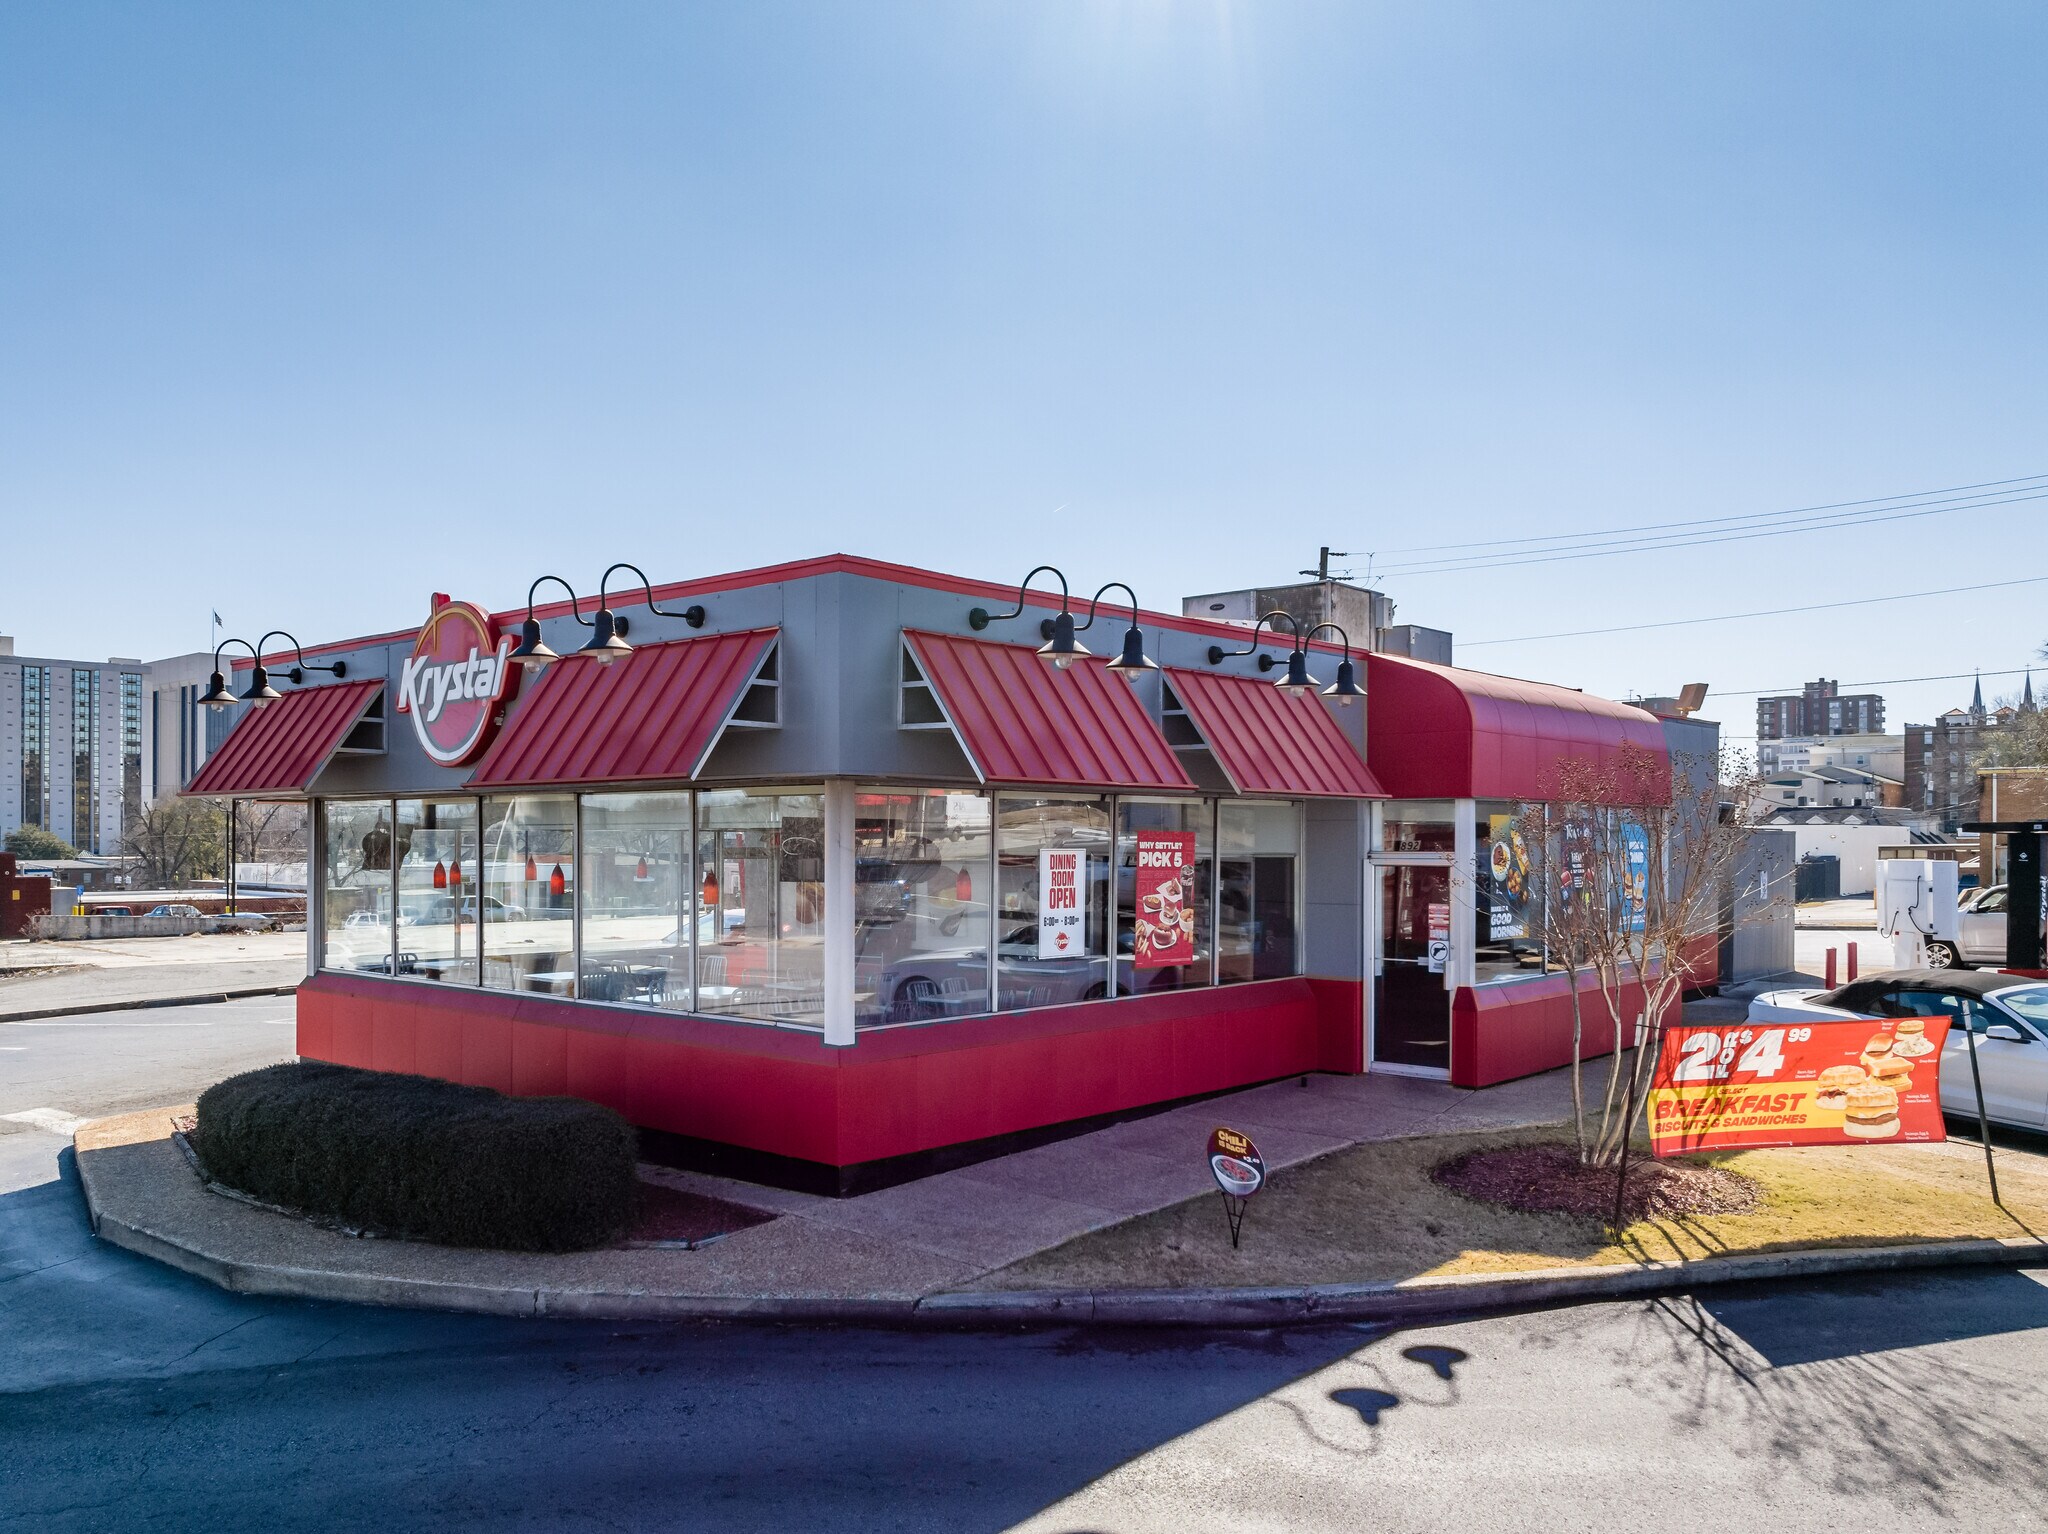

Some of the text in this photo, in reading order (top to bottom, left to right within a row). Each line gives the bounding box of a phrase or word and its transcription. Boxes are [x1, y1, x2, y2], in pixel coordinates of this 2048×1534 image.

[398, 643, 508, 722] Krystal
[1401, 841, 1420, 850] 892
[1049, 854, 1077, 870] DINING
[1139, 851, 1182, 868] PICK 5
[1051, 871, 1075, 887] ROOM
[1049, 888, 1076, 909] OPEN
[1491, 913, 1512, 925] GOOD
[1490, 925, 1524, 938] MORNING
[1672, 1032, 1722, 1081] 2
[1715, 1031, 1740, 1079] FOR
[1718, 1087, 1749, 1095] SELECT
[1653, 1092, 1808, 1120] BREAKFAST
[1654, 1114, 1807, 1133] BISCUITS & SANDWICHES
[1218, 1130, 1248, 1148] CHILI
[1225, 1142, 1247, 1155] BACK
